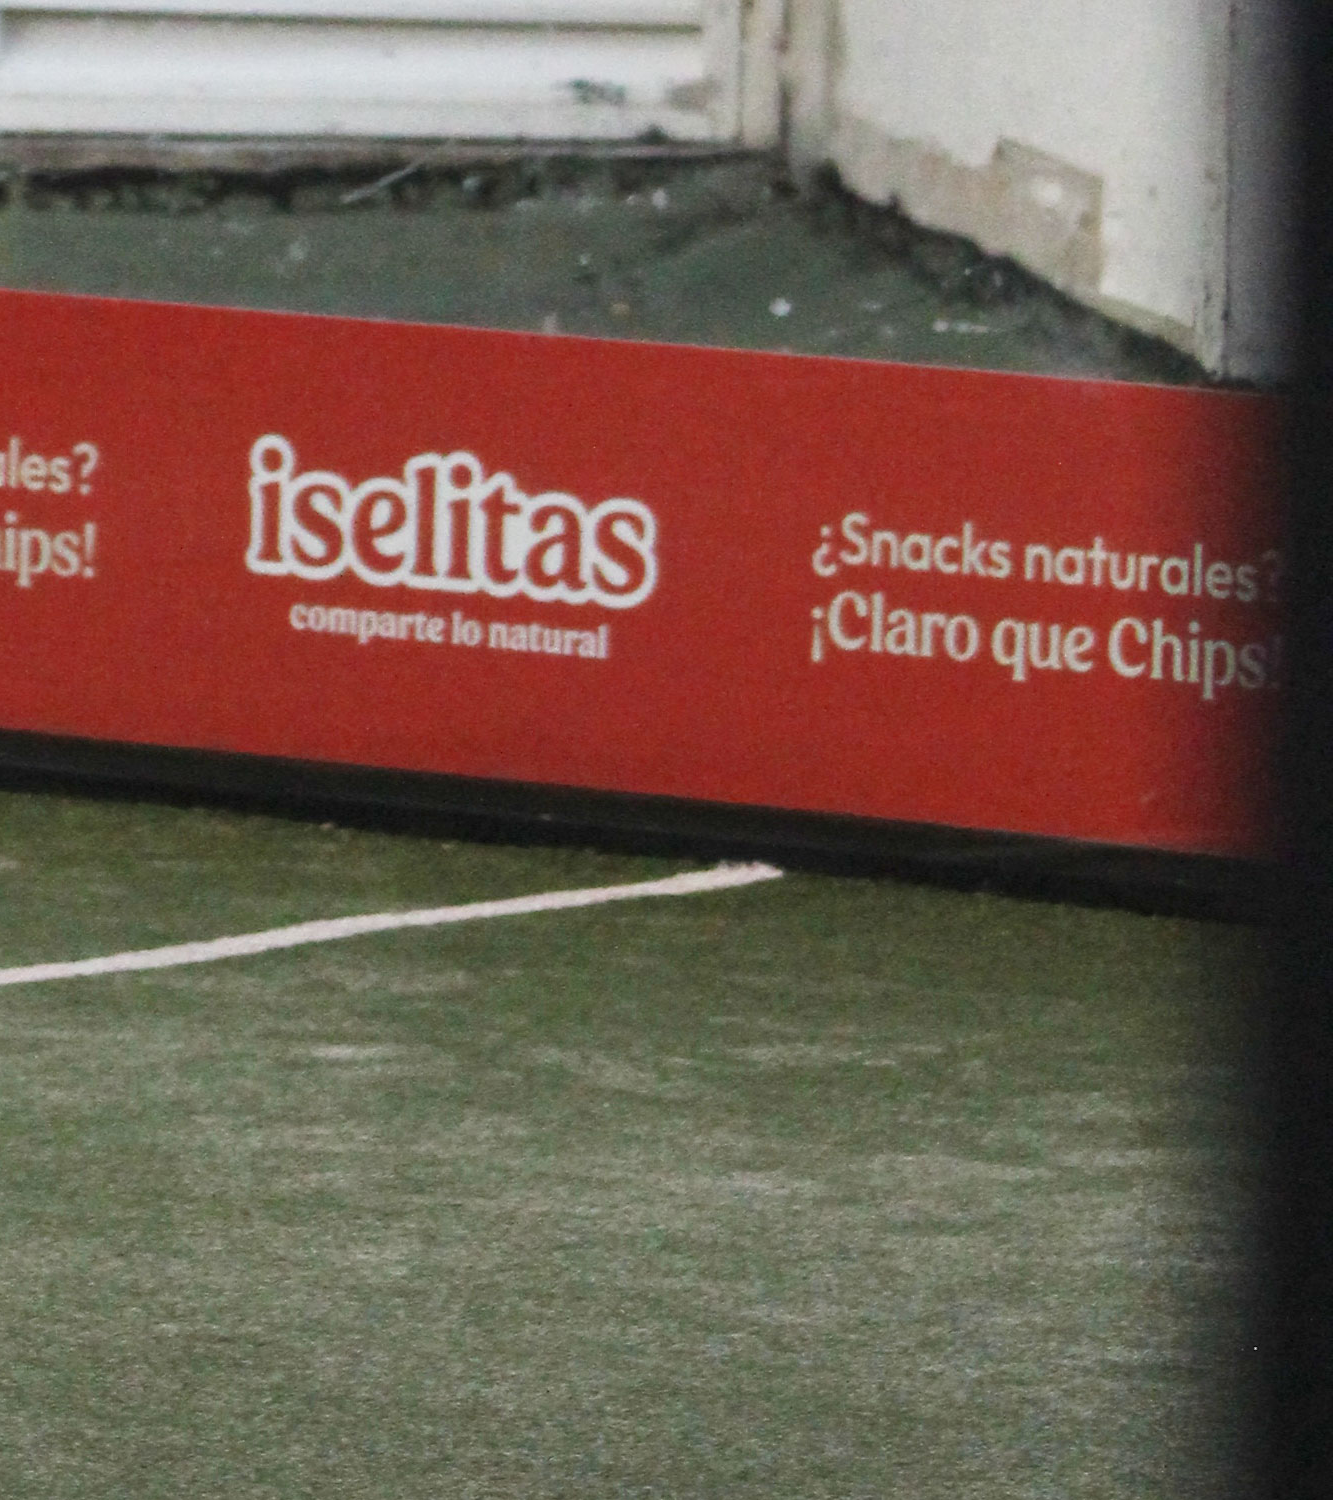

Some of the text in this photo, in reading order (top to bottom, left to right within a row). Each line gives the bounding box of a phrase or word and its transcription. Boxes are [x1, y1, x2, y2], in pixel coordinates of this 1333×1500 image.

[244, 433, 658, 609] iselitas
[810, 511, 1014, 579] ¿Snacks
[288, 601, 610, 661] comparte lo natural
[809, 590, 981, 663] ¡Claro
[991, 617, 1096, 682] que
